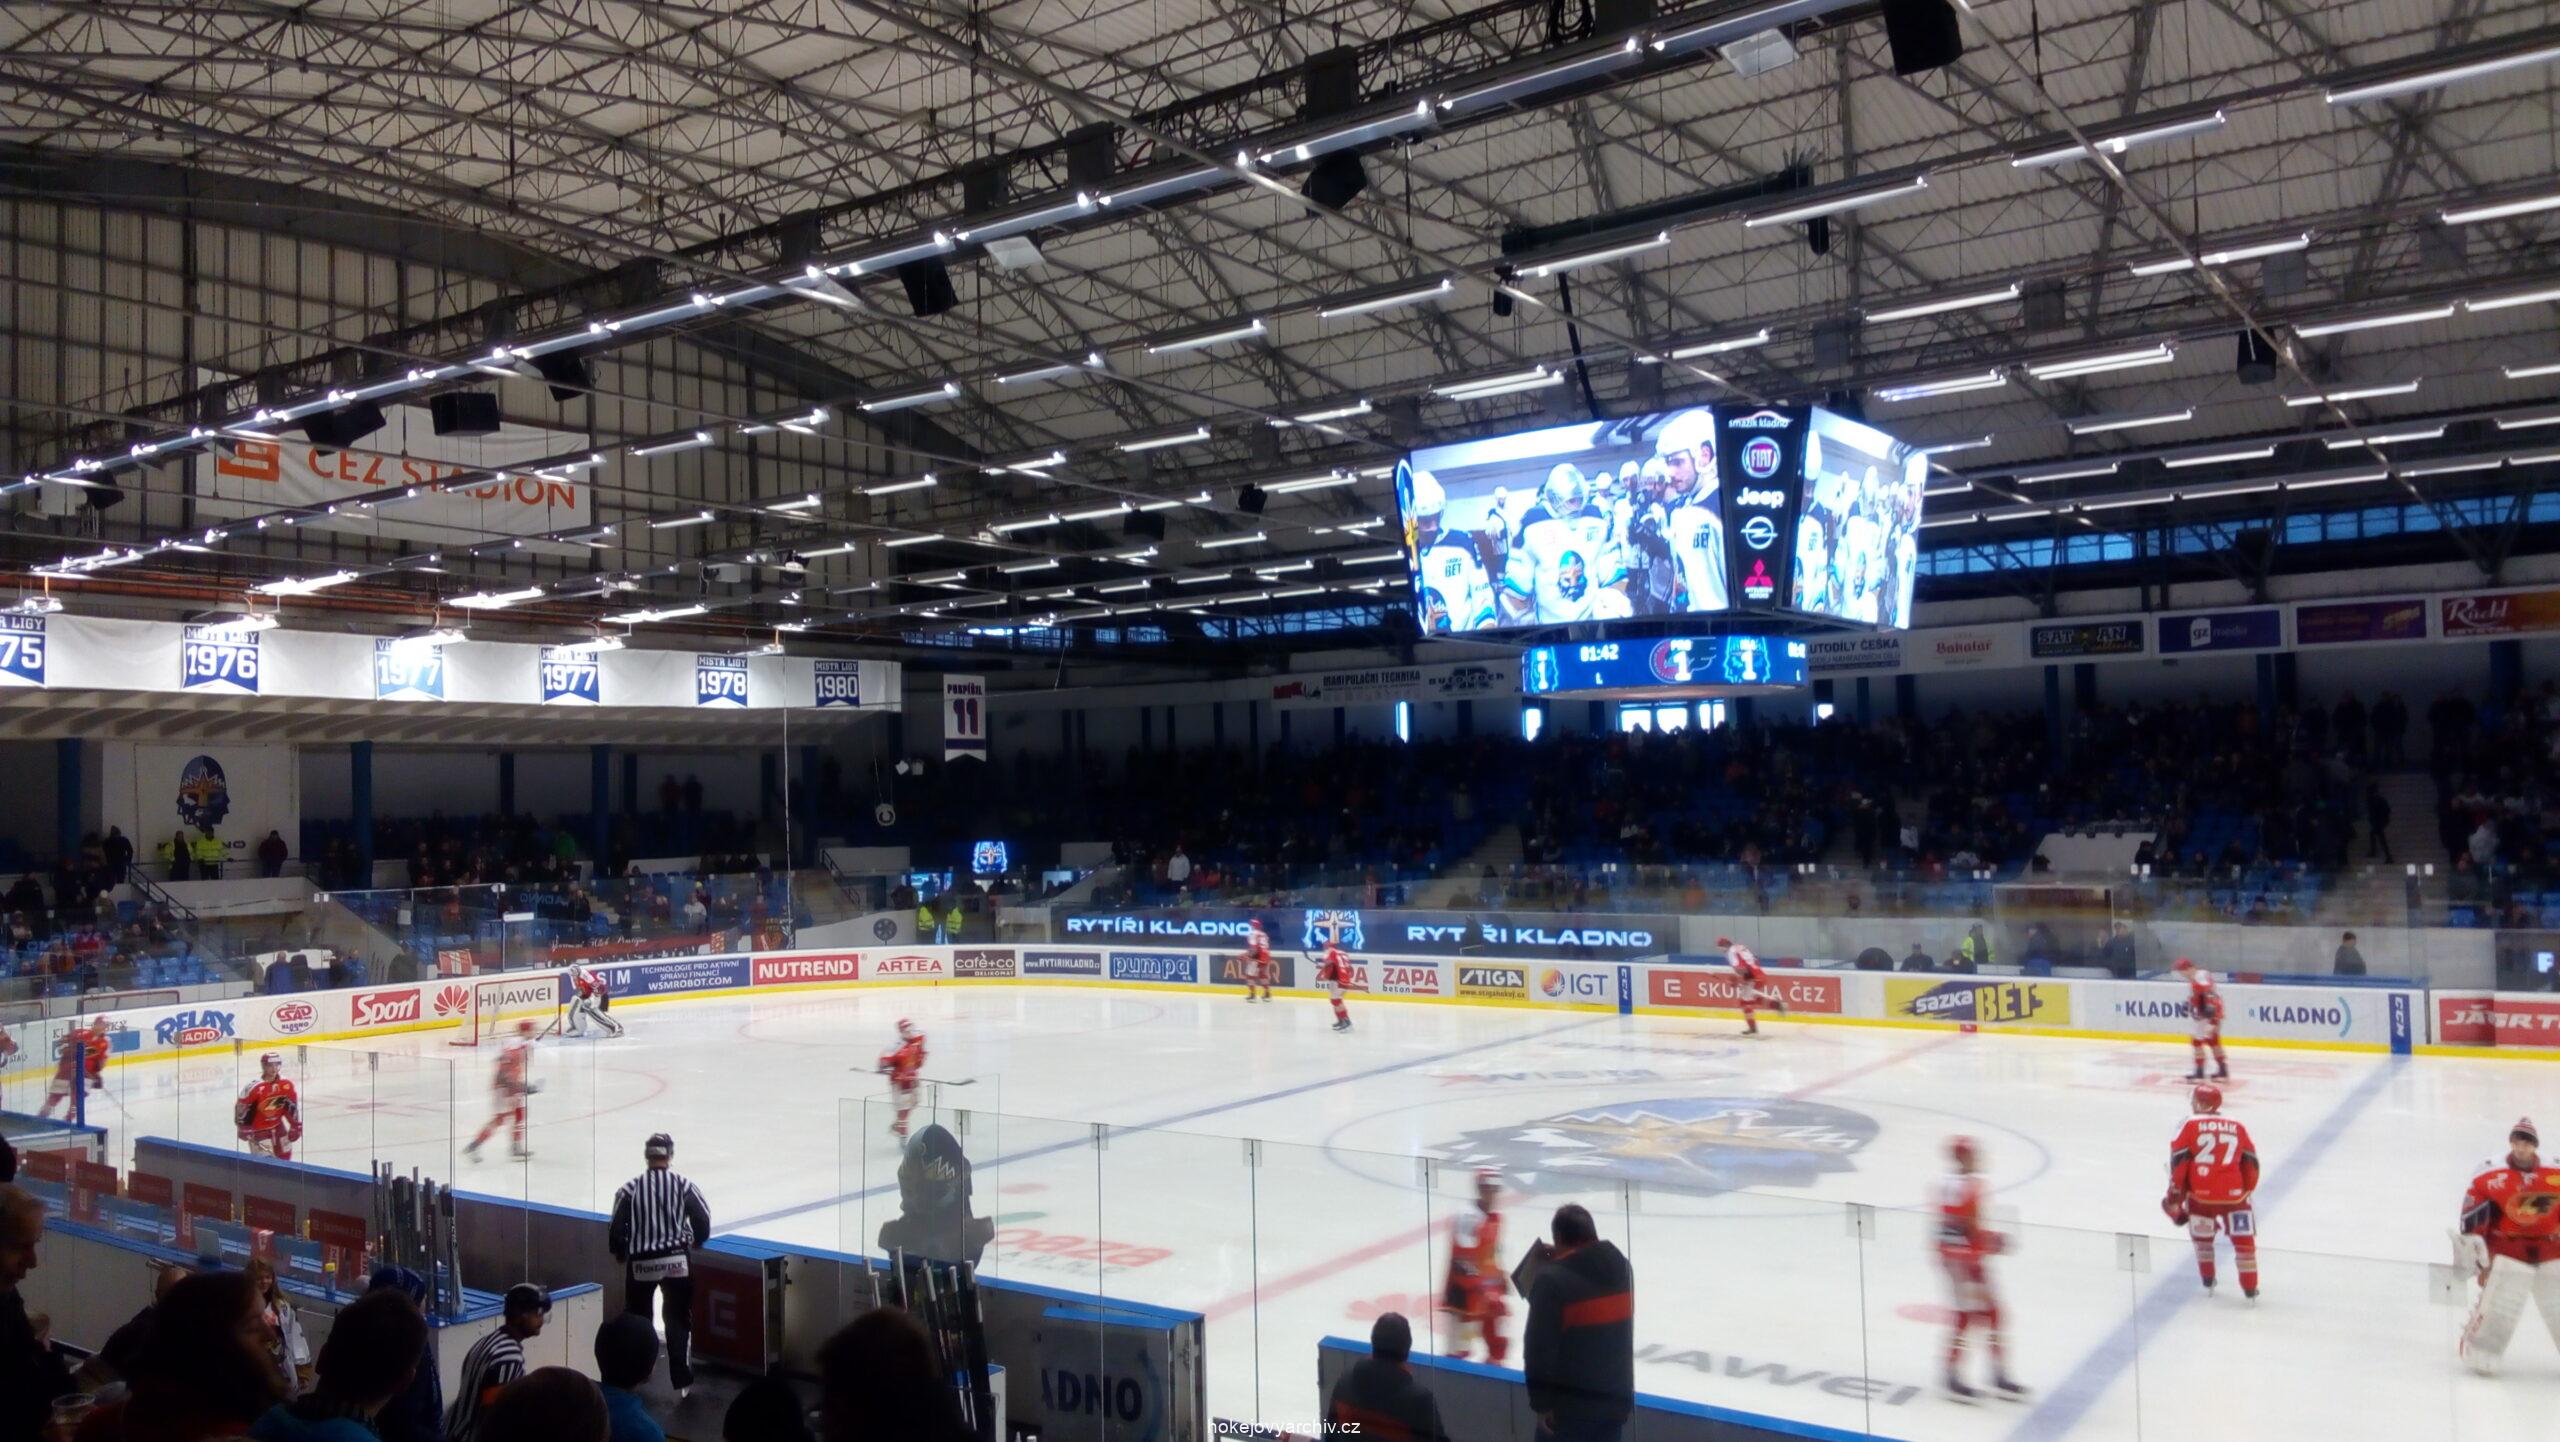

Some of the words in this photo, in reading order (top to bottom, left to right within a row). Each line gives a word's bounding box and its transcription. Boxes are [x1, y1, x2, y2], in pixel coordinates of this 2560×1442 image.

[1750, 449, 1772, 467] FIAT
[1737, 487, 1784, 508] Jeep
[12, 616, 43, 629] LIGY
[1580, 645, 1618, 662] 01:42
[1809, 640, 1856, 654] UTODÍLY
[187, 644, 257, 678] 1976
[698, 656, 725, 666] MISTR
[815, 661, 839, 670] MISTR
[1673, 652, 1691, 682] 1
[1741, 651, 1757, 681] 1
[544, 664, 596, 691] 1977
[699, 671, 746, 696] 1978
[817, 676, 858, 698] 1980
[953, 698, 978, 735] 11
[1067, 917, 1144, 934] RYTÍŘI
[1150, 920, 1252, 936] KLADNO
[1408, 924, 1507, 943] RYTŘI
[1516, 928, 1653, 946] KLADNO
[641, 964, 692, 974] TECHNOLOGIE
[694, 962, 709, 970] PRO
[710, 959, 740, 969] AKTIVNÍ
[660, 970, 687, 980] SPRÁVU
[758, 958, 853, 979] NUTREND
[876, 960, 943, 973] ARTEA
[1113, 956, 1190, 980] pumpa
[1223, 959, 1280, 984] ALQ
[1382, 967, 1439, 986] ZAPA
[648, 976, 733, 991] WSMROBOT.COM
[1461, 969, 1523, 987] STIGA
[1570, 973, 1608, 995] IGT
[479, 987, 551, 1008] HUAWEI
[1382, 985, 1411, 994] beton
[1698, 981, 1783, 1001] SKUA
[1789, 980, 1825, 1003] ČEZ
[1975, 983, 2031, 1021] BET
[2259, 1005, 2342, 1026] KLADNO
[155, 1010, 237, 1045] RELAX
[2194, 1133, 2238, 1166] 27
[1634, 1344, 1921, 1405] AWEI
